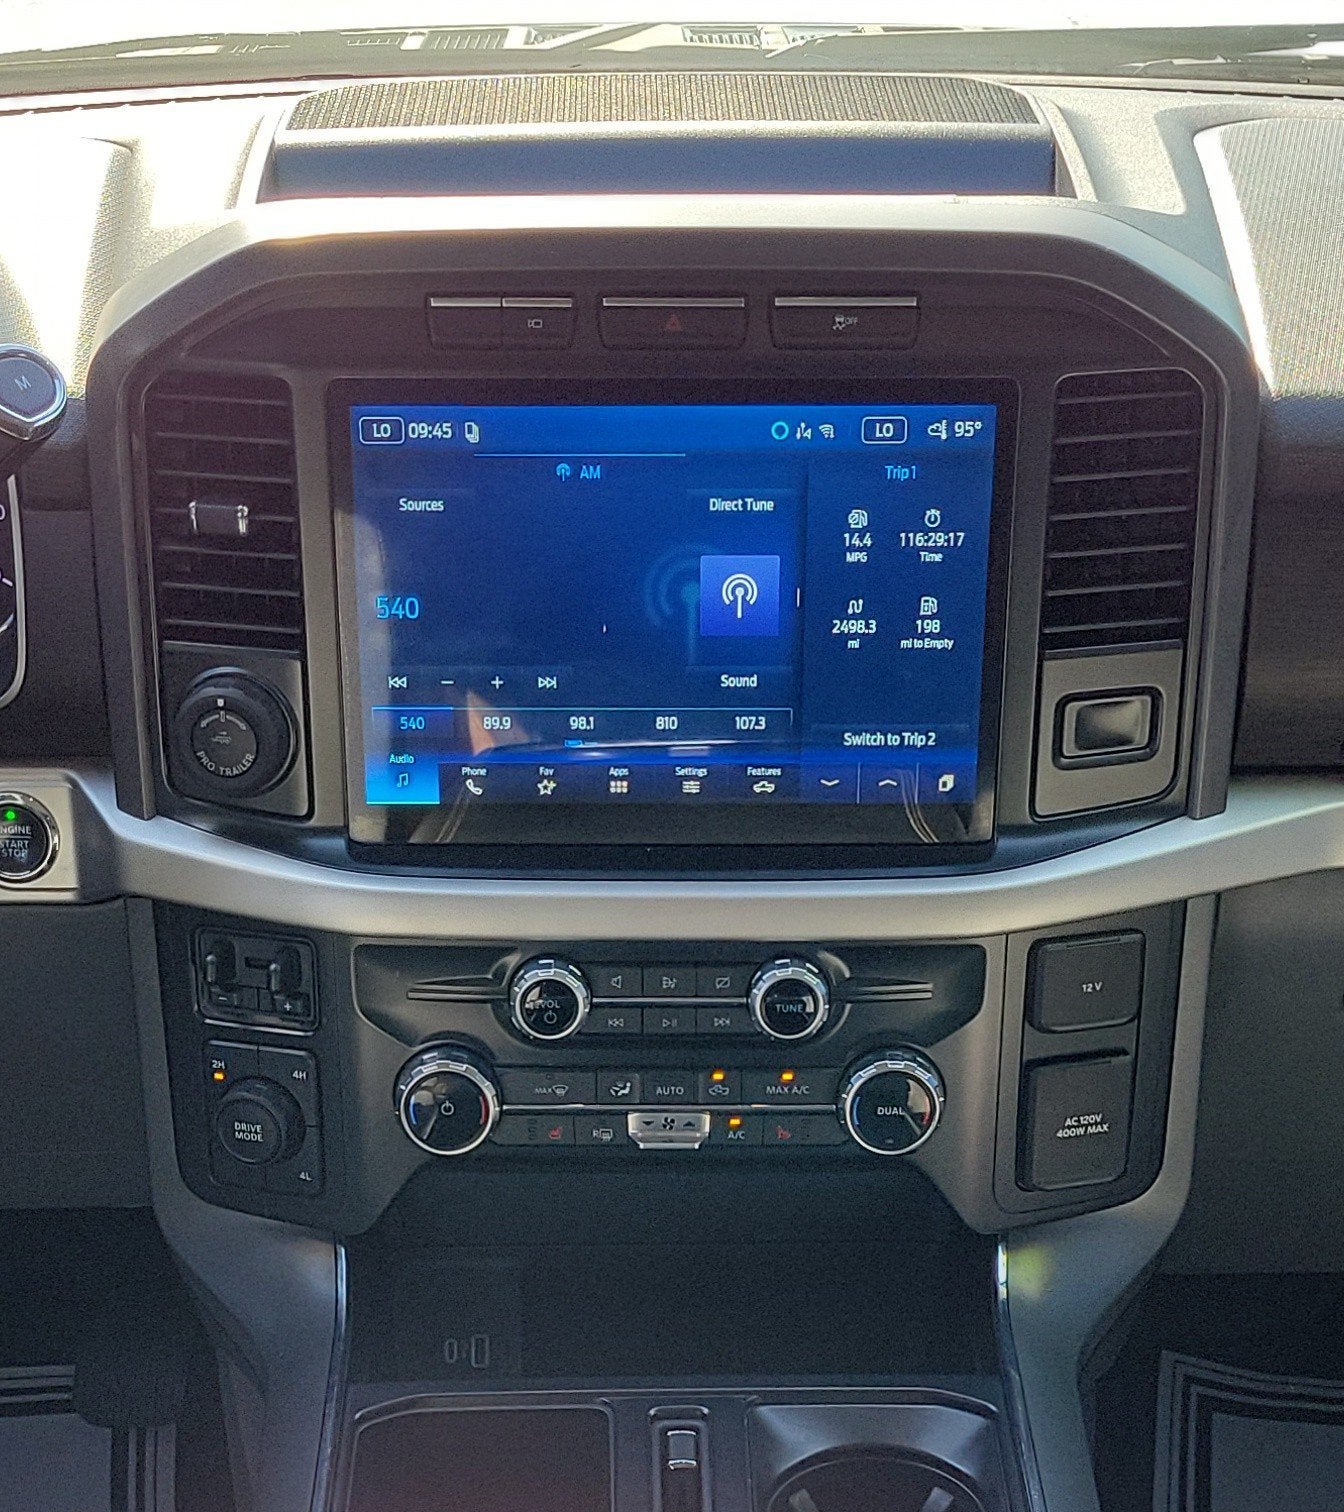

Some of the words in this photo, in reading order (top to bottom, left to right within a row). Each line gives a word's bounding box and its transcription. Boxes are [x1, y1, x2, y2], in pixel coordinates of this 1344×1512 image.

[372, 423, 392, 438] LO
[408, 422, 453, 439] 09:45
[874, 422, 894, 438] LO
[579, 464, 602, 480] AM
[884, 465, 909, 482] Trip
[398, 497, 445, 512] Sources
[709, 497, 743, 512] Direct
[744, 497, 775, 512] Tune
[843, 532, 872, 548] 14.4
[899, 531, 965, 547] 116:29:17
[846, 551, 868, 563] MPG
[919, 551, 943, 562] Time
[375, 596, 420, 620] 540
[831, 619, 877, 634] 2498.3
[915, 619, 941, 634] 198
[847, 639, 860, 649] mi
[900, 639, 913, 649] mi
[913, 639, 923, 649] to
[924, 639, 955, 651] Empty
[720, 674, 758, 688] Sound
[399, 716, 425, 730] 540
[482, 716, 512, 730] 89.9
[569, 716, 595, 730] 98.1
[655, 716, 678, 730] 810
[735, 716, 766, 730] 107.3
[843, 732, 885, 747] Switch
[886, 733, 901, 746] to
[902, 732, 926, 748] Trip
[927, 732, 936, 746] 2
[196, 750, 216, 771] PRO
[219, 753, 256, 776] TRAILER
[389, 753, 415, 764] Audio
[461, 766, 487, 776] Phone
[539, 766, 555, 776] Fav
[608, 766, 629, 777] Apps
[675, 766, 708, 777] Settings
[746, 766, 782, 776] Features
[1081, 983, 1094, 993] 12
[1094, 982, 1103, 991] V
[774, 1003, 804, 1013] TUNE
[211, 1060, 225, 1069] 2H
[292, 1070, 307, 1080] 4H
[656, 1086, 684, 1096] AUTO
[766, 1085, 789, 1095] MAX
[791, 1085, 810, 1095] A/C
[876, 1106, 905, 1116] DUAL
[234, 1121, 263, 1133] DRIVE
[1064, 1116, 1079, 1127] AC
[1078, 1113, 1103, 1125] 120V
[235, 1131, 264, 1142] MODE
[727, 1130, 746, 1140] A/C
[1056, 1125, 1087, 1139] 400W
[1086, 1122, 1110, 1134] MAX
